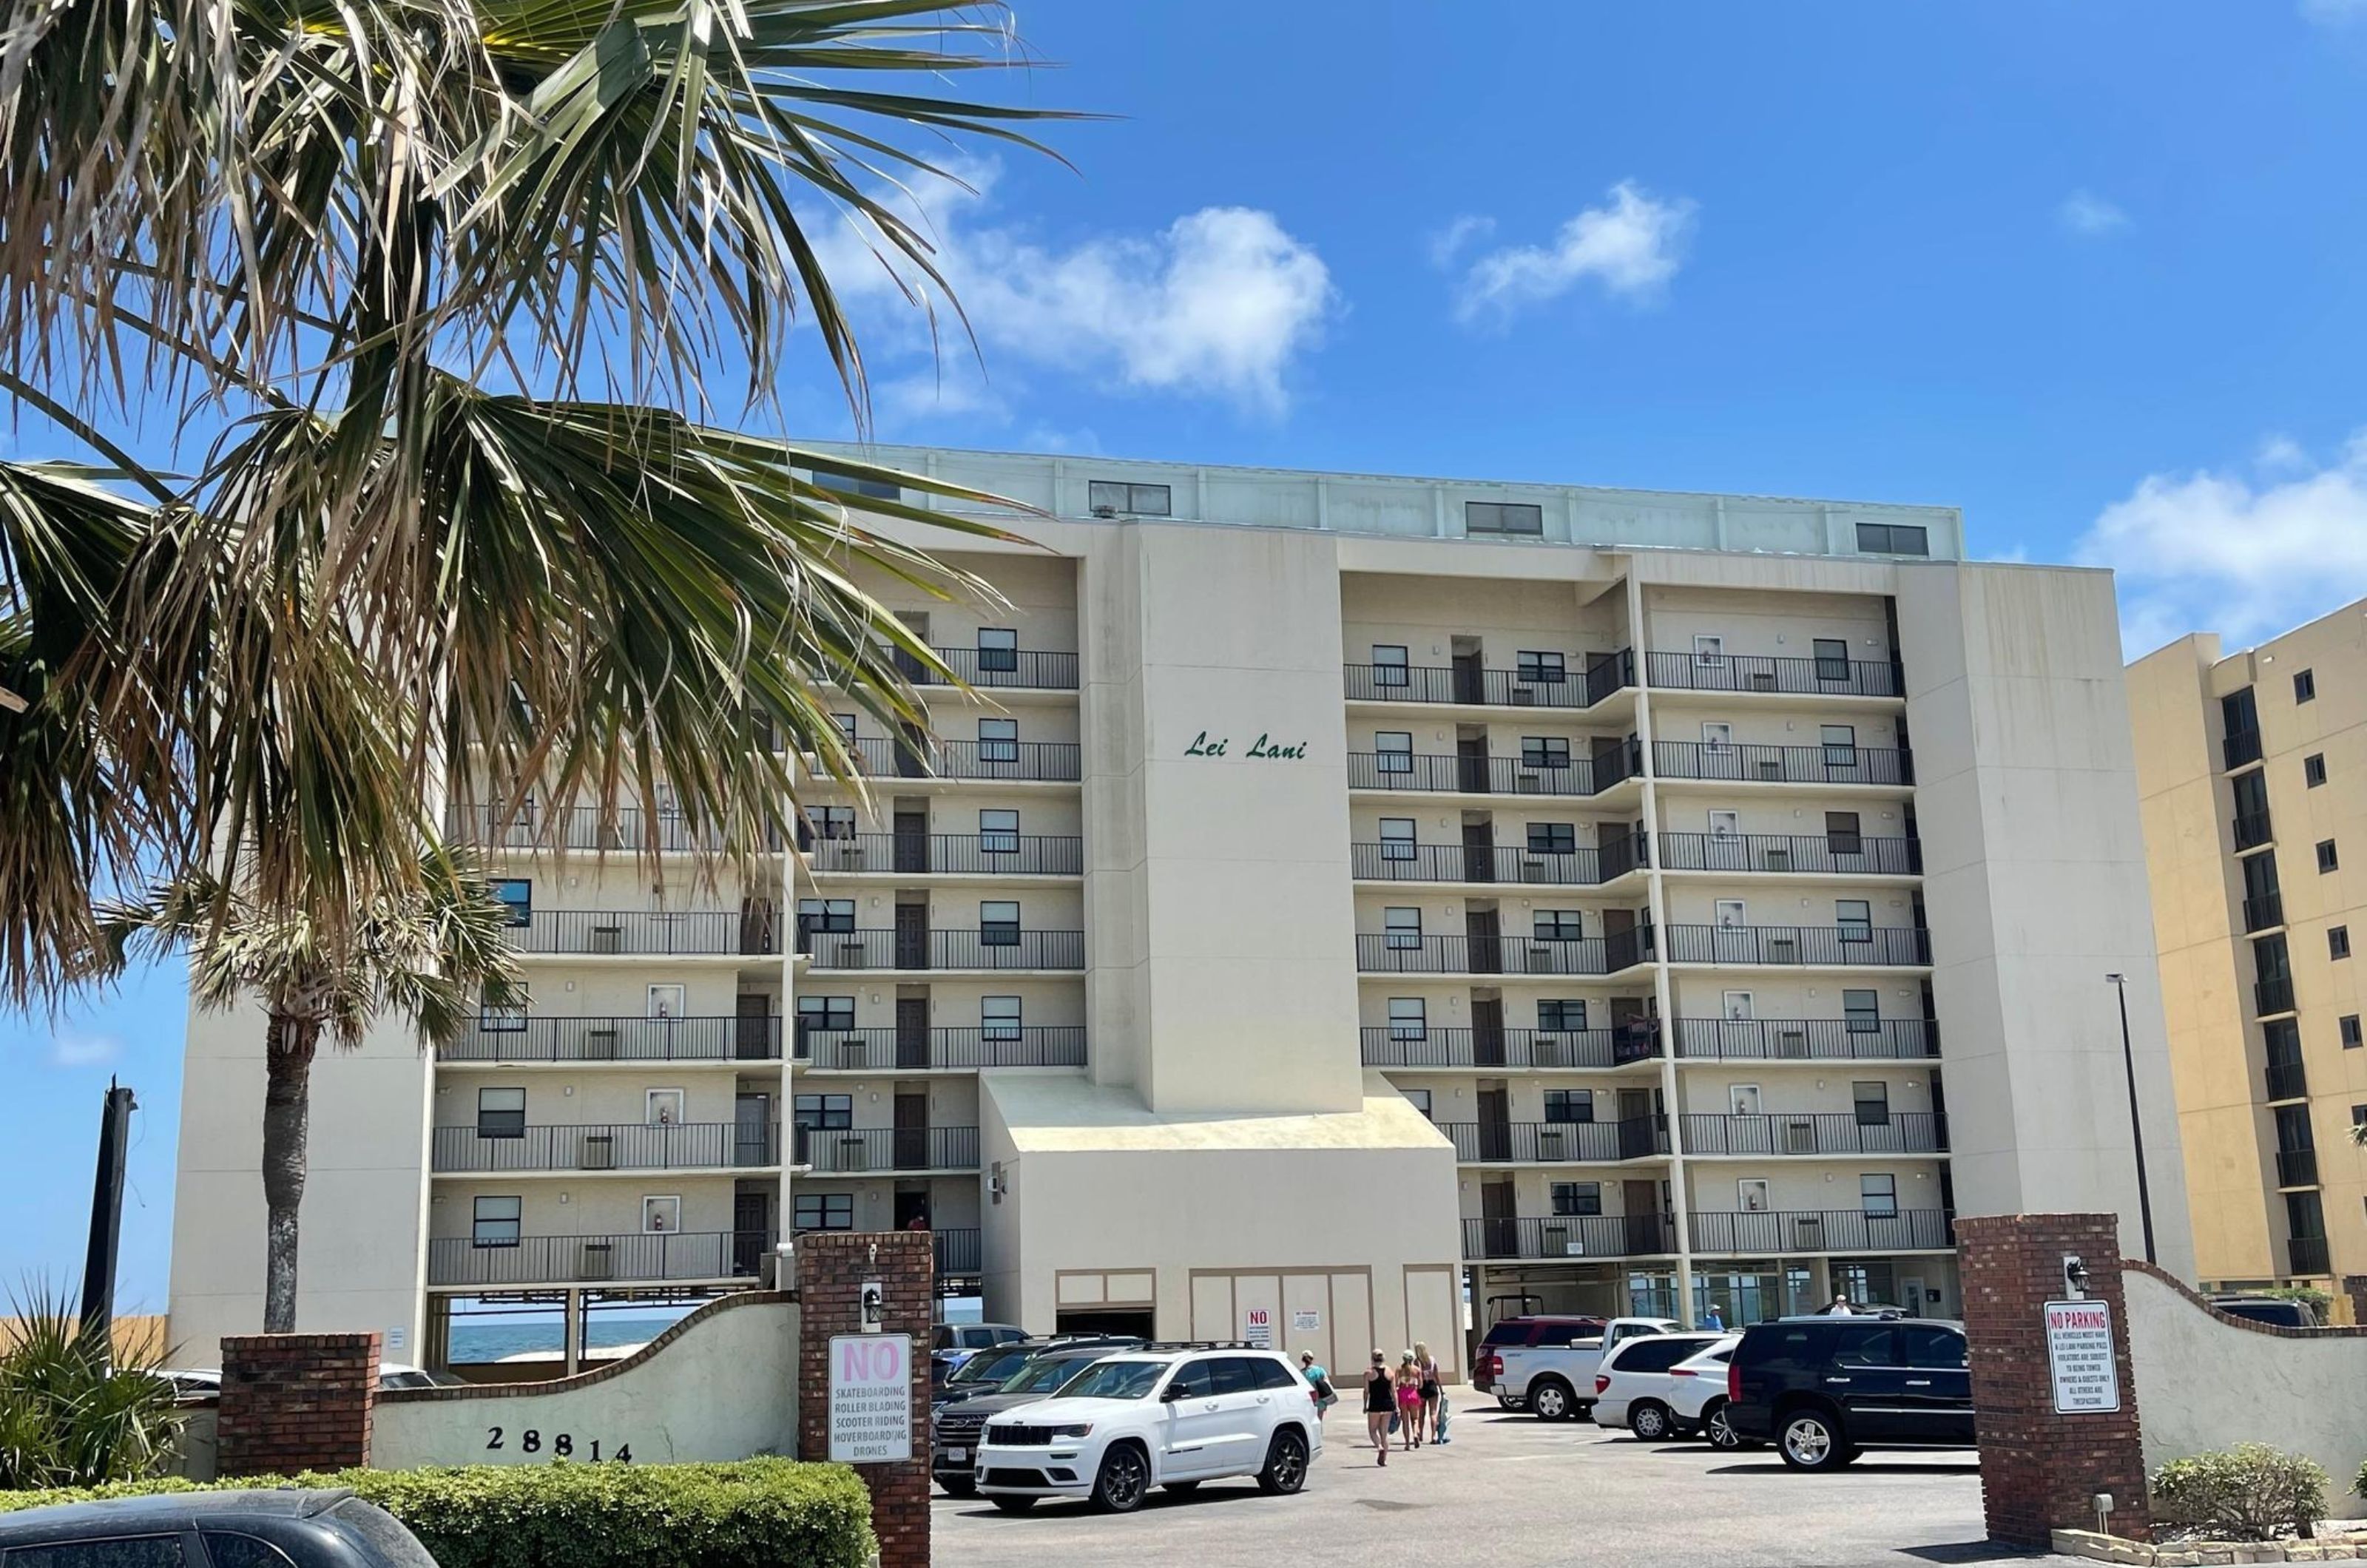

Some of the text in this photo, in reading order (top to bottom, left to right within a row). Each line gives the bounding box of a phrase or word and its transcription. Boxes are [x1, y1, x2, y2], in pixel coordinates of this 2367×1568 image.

[1184, 731, 1307, 759] Lei Lani
[1250, 1311, 1267, 1324] NO
[2050, 1311, 2105, 1329] NO PARKING
[844, 1341, 899, 1382] NO
[835, 1386, 905, 1399] SKATEBOARDING
[835, 1400, 906, 1413] ROLLER BLADING
[836, 1415, 905, 1428] SCOOTER RIDING
[834, 1430, 907, 1443] HOVERBOARDING
[486, 1427, 632, 1464] 28814
[854, 1445, 888, 1457] DRONES
